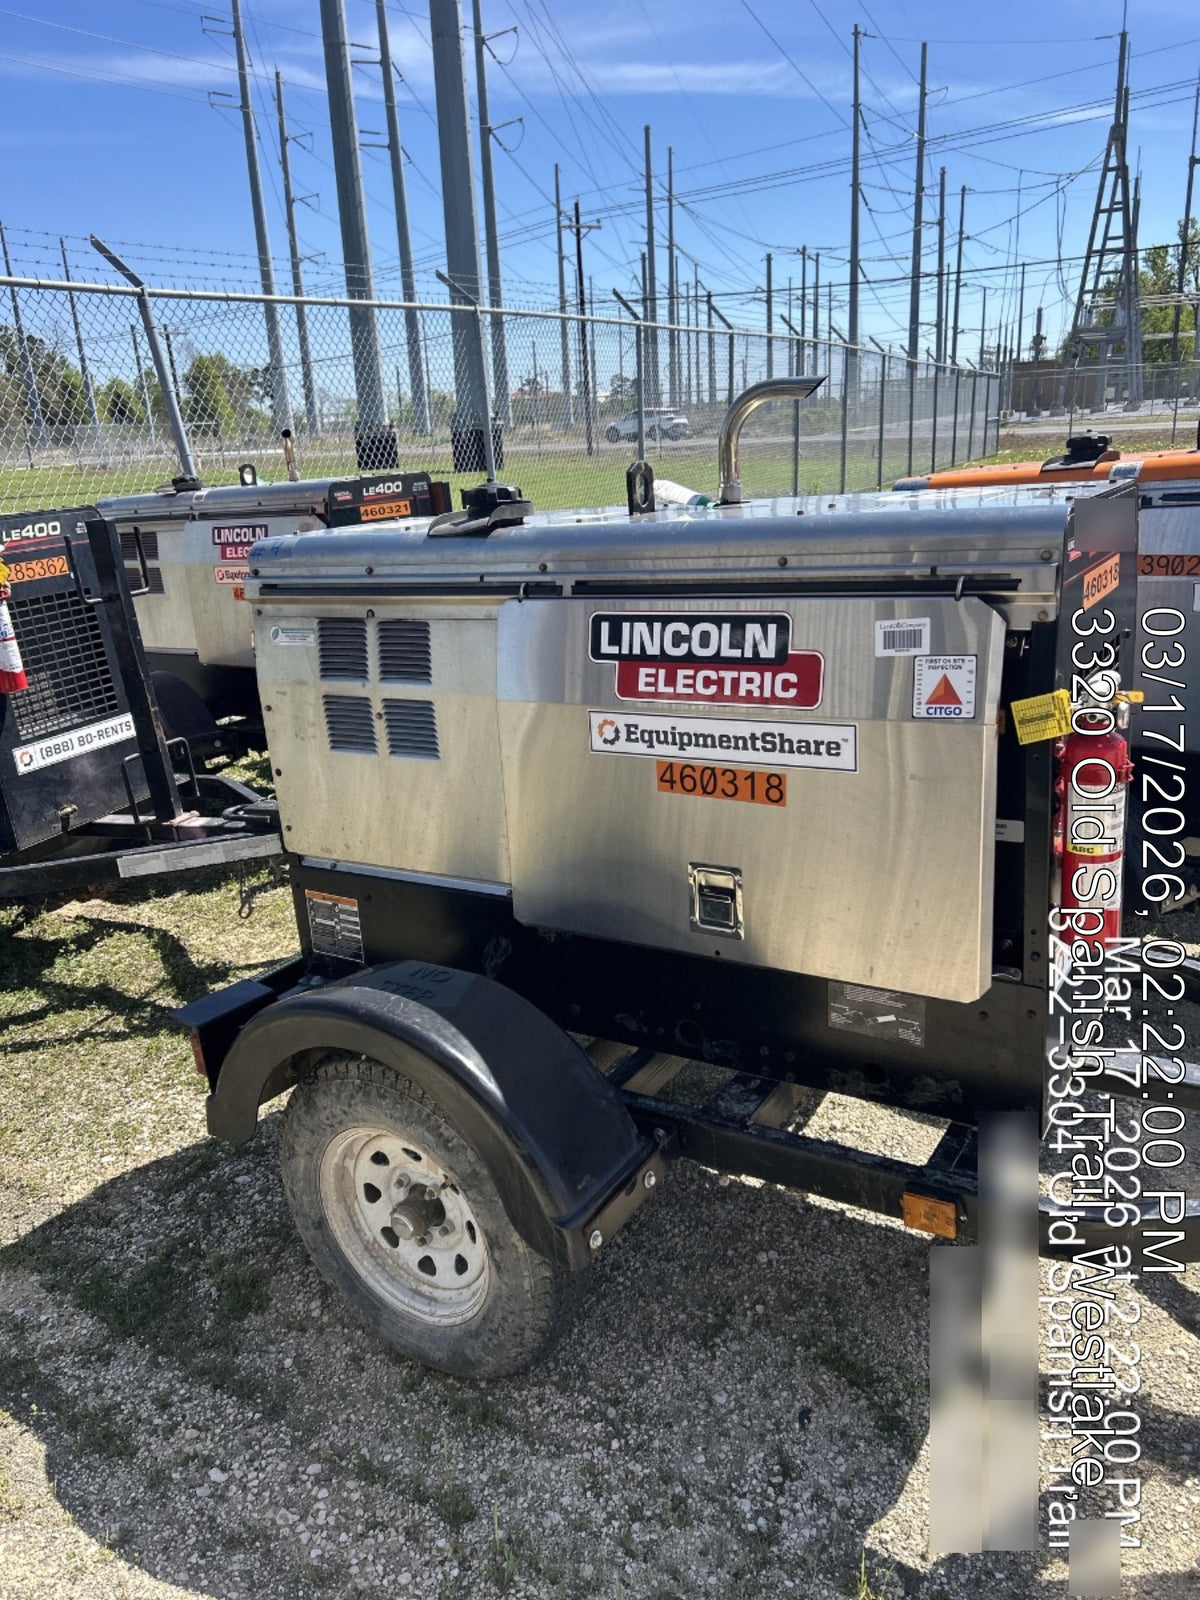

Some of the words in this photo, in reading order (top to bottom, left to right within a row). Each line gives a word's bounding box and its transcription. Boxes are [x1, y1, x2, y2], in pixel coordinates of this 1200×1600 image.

[362, 481, 403, 496] LE400
[361, 504, 409, 518] 460321
[2, 521, 61, 541] LE400
[214, 526, 265, 544] LINCOLN
[226, 546, 253, 558] ELEC
[600, 620, 778, 658] LINCOLN
[638, 667, 799, 699] ELECTRIC
[926, 706, 963, 716] CITGO
[40, 738, 74, 760] (888)
[659, 761, 786, 804] 460318
